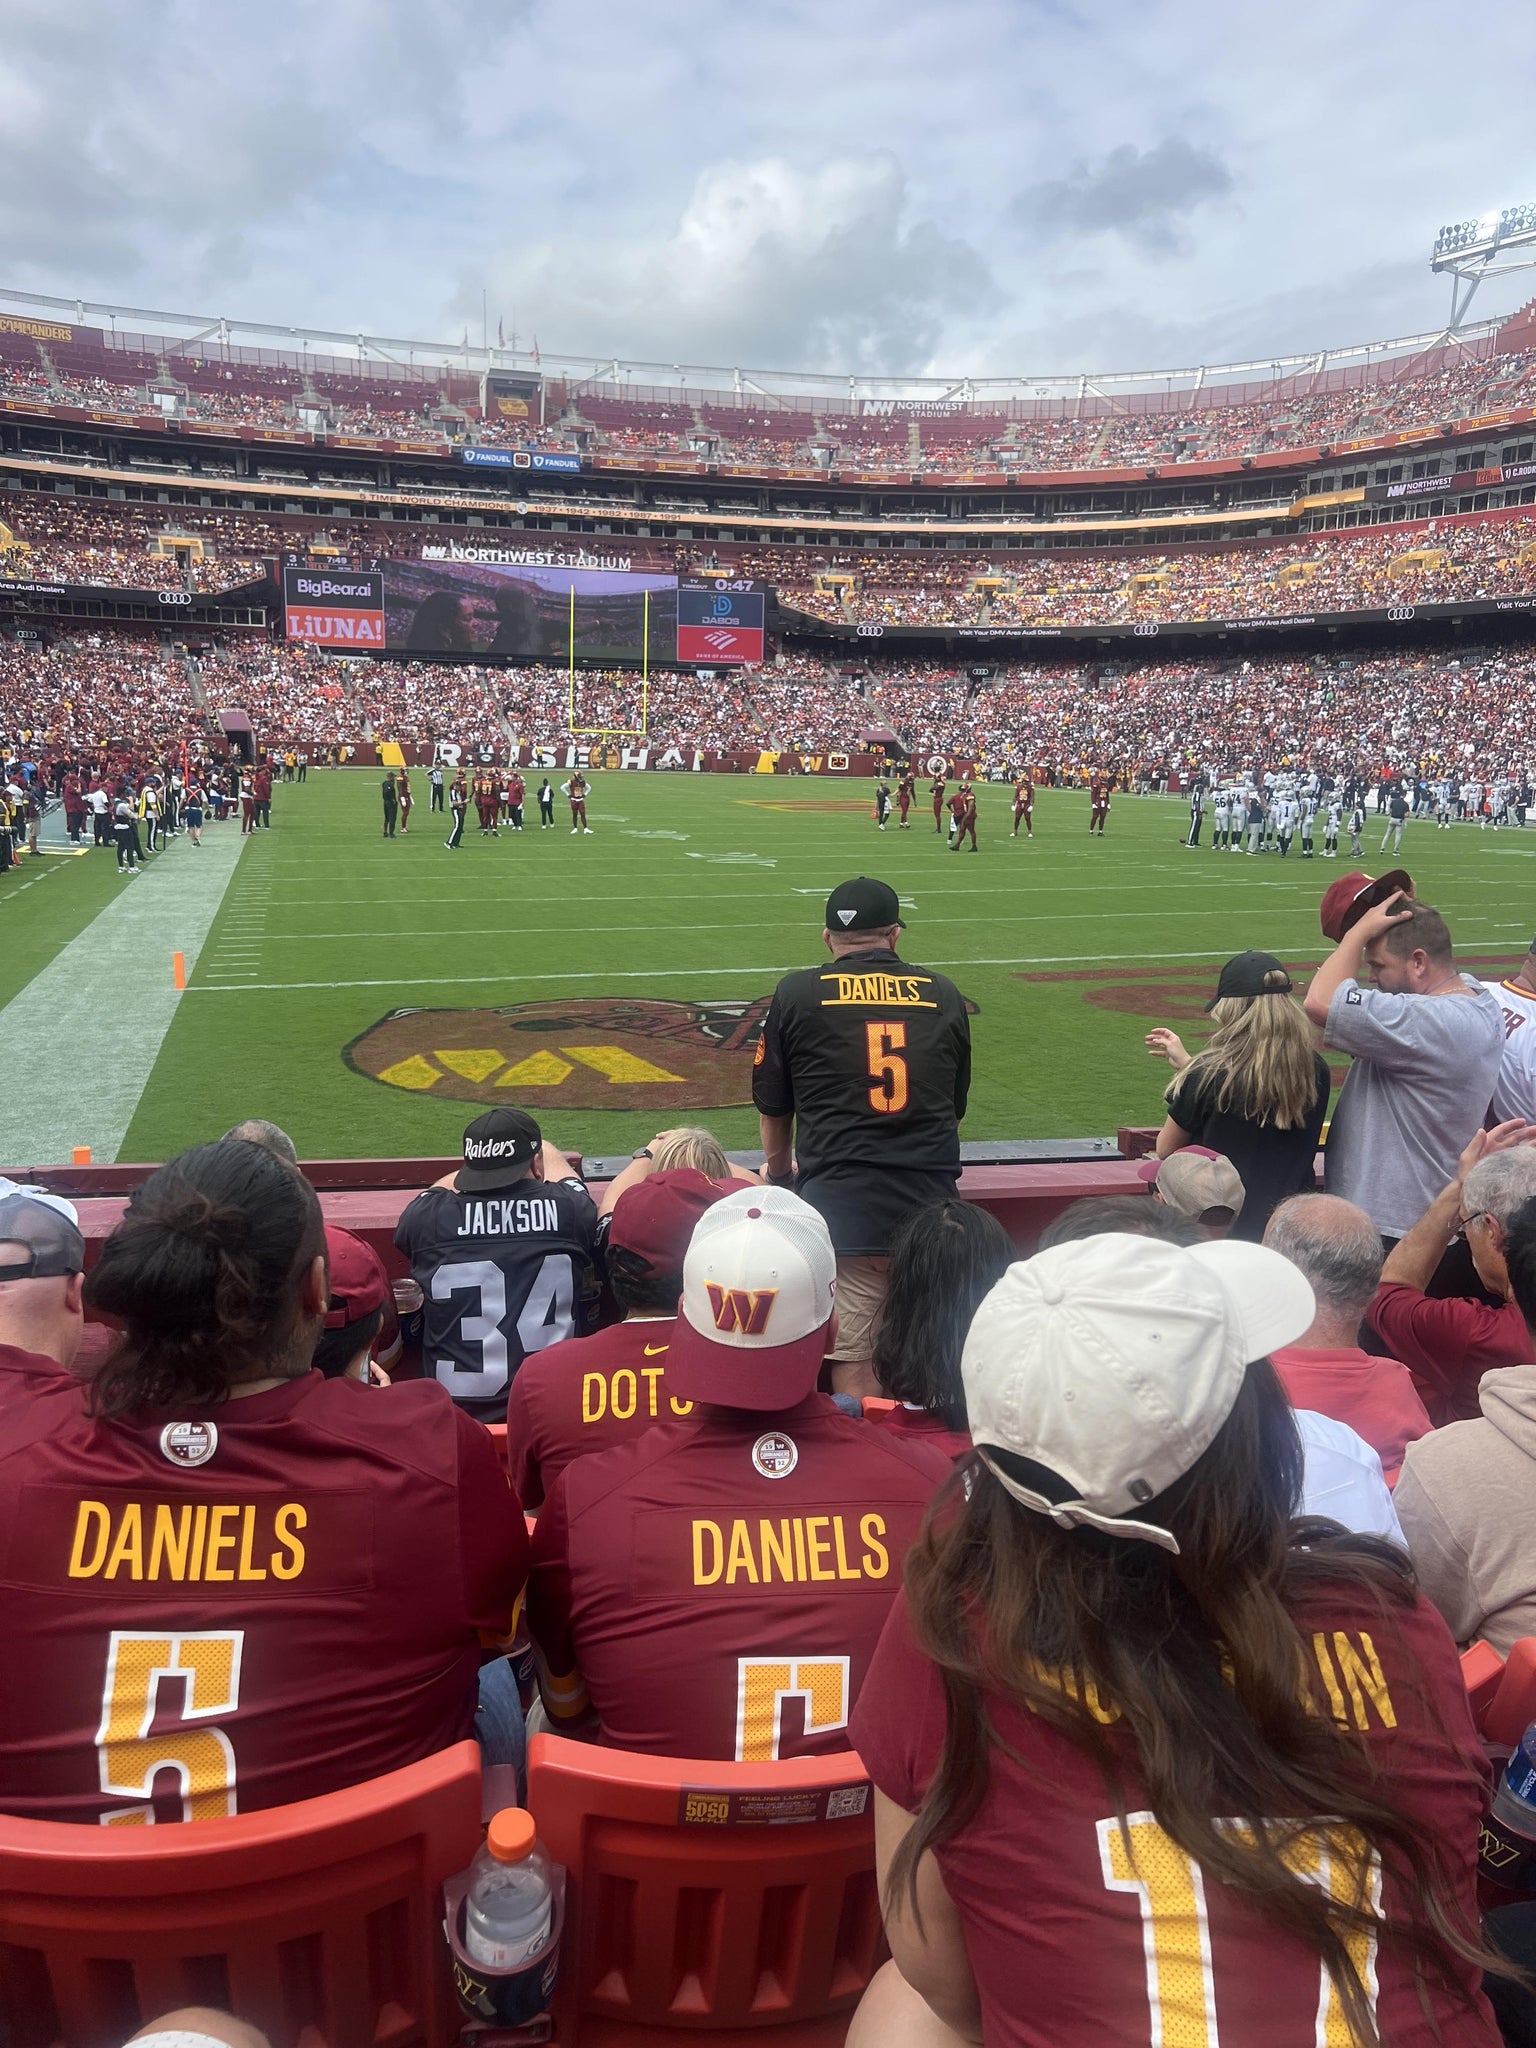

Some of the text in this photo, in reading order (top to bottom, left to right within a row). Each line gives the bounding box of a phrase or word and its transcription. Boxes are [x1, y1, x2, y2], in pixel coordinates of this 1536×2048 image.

[0, 319, 73, 340] COMMANDERS
[896, 401, 964, 411] NORTHWEST
[910, 410, 950, 418] STADIUM
[476, 453, 511, 463] FANDUEL
[545, 458, 579, 468] FANDUEL
[1406, 476, 1453, 490] NORTHWEST
[369, 493, 395, 502] TIME
[400, 496, 441, 505] WORLD
[444, 499, 511, 510] CHAMPIONS
[534, 505, 681, 521] 1937 1942 1982 1987 1991
[289, 554, 297, 563] 3
[326, 556, 348, 565] 7:49
[370, 559, 378, 568] 7
[451, 547, 554, 564] NORTHWEST
[557, 553, 631, 569] STADIUM
[16, 583, 35, 591] Audi
[36, 585, 66, 594] Dealers
[297, 579, 372, 597] BigBear.ai
[714, 578, 754, 592] 0:47
[1496, 601, 1513, 609] Visit
[1514, 600, 1531, 608] Your
[289, 615, 382, 641] LiUNA!
[702, 616, 740, 626] DABOS
[832, 757, 845, 767] 25
[1284, 805, 1289, 818] 1
[838, 977, 920, 1002] DANIELS
[865, 1020, 909, 1114] 5
[464, 1137, 516, 1160] Raiders
[457, 1199, 559, 1236] JACKSON
[704, 1279, 779, 1335] W
[431, 1253, 577, 1398] 34
[68, 1500, 307, 1581] DANIELS
[692, 1513, 890, 1586] DANIELS
[95, 1630, 245, 1826] 5
[783, 1793, 822, 1801] LUCKY?
[685, 1816, 728, 1825] RAFFLE
